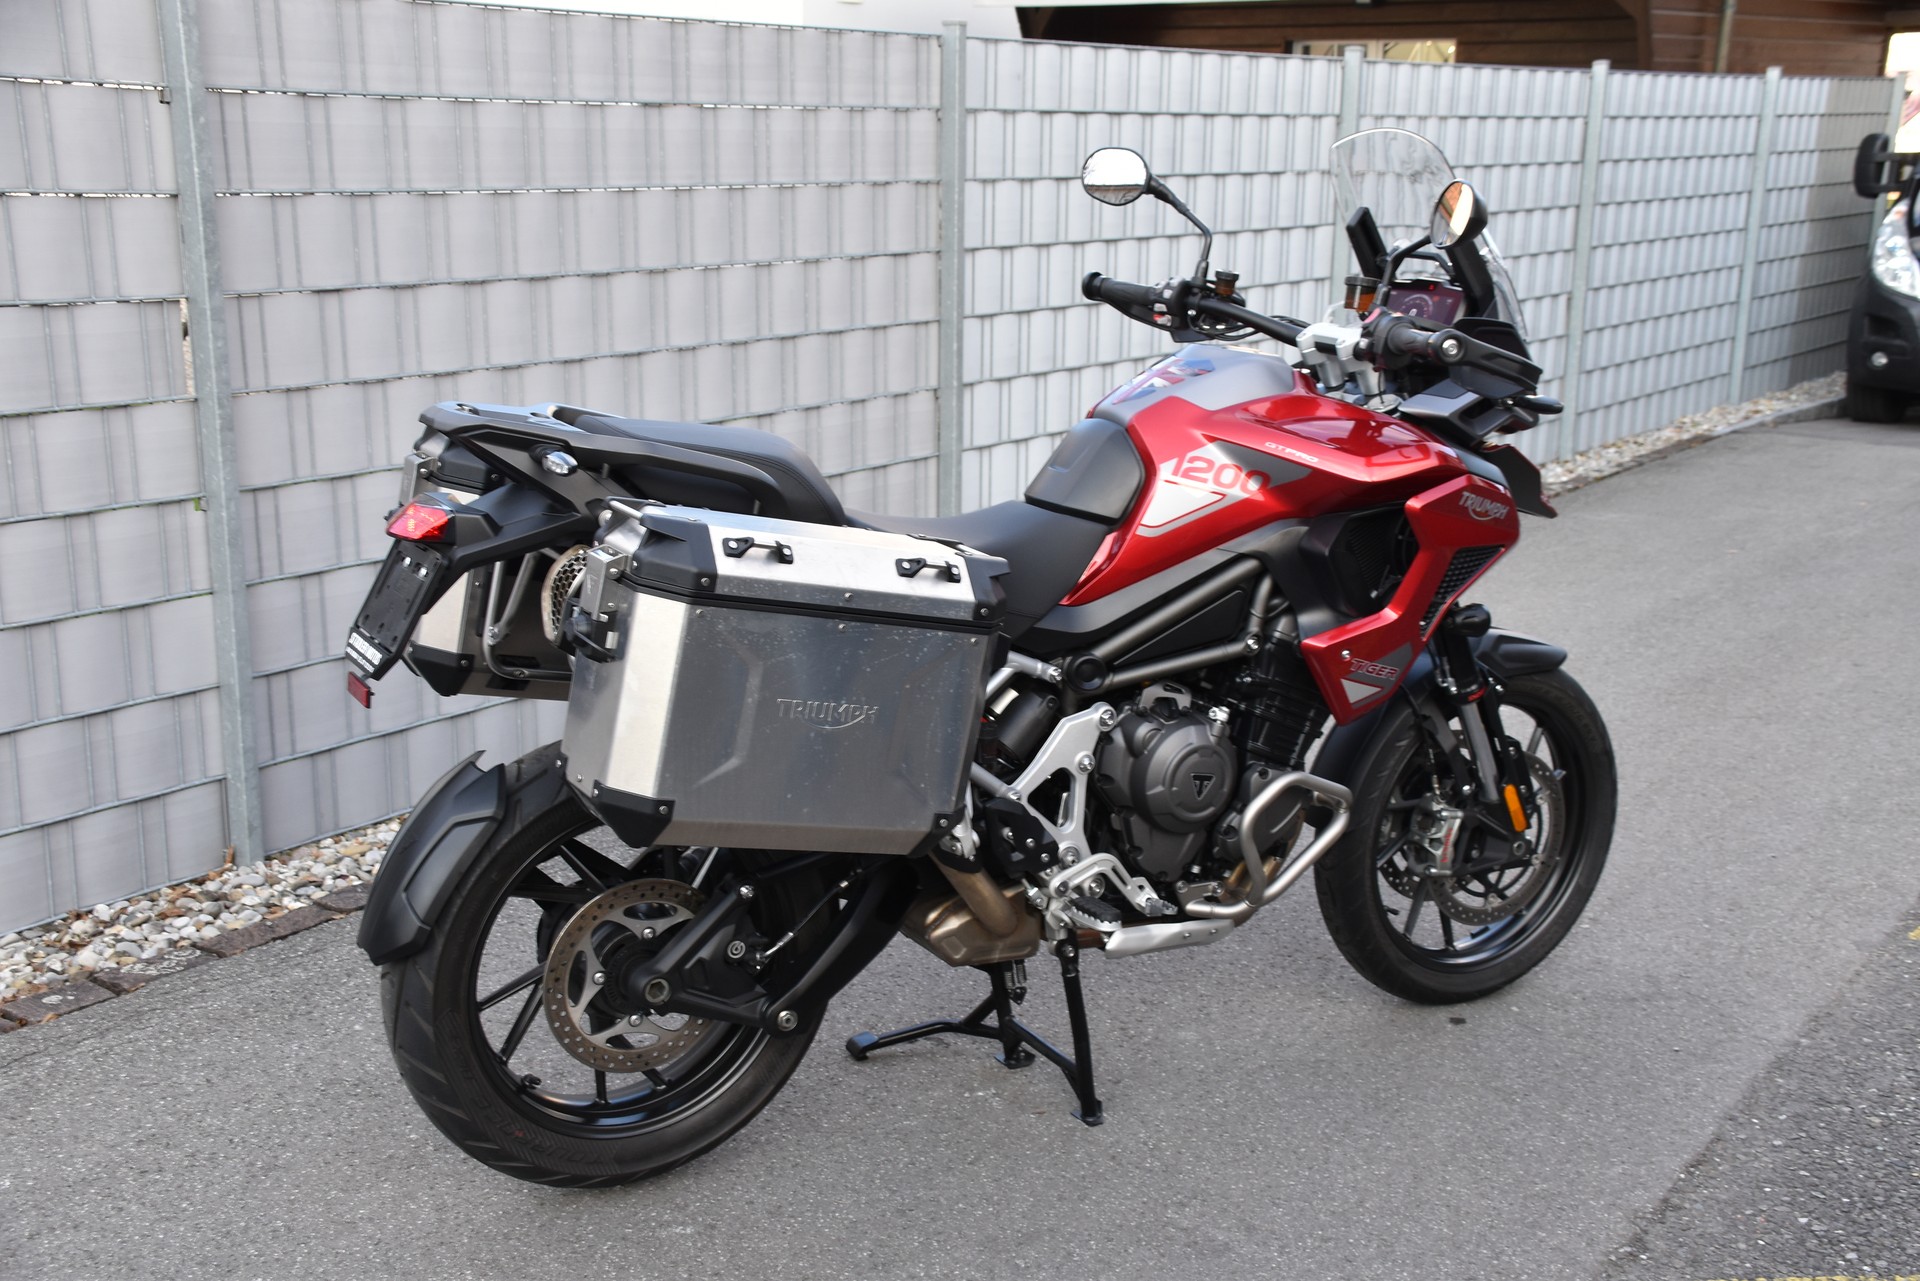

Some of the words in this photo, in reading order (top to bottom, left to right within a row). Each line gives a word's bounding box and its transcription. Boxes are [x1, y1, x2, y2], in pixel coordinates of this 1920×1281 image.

[1171, 455, 1272, 502] 1200
[1458, 490, 1510, 520] TRIUMPH
[1350, 657, 1400, 681] TIGER
[776, 698, 880, 729] TRIUMPH
